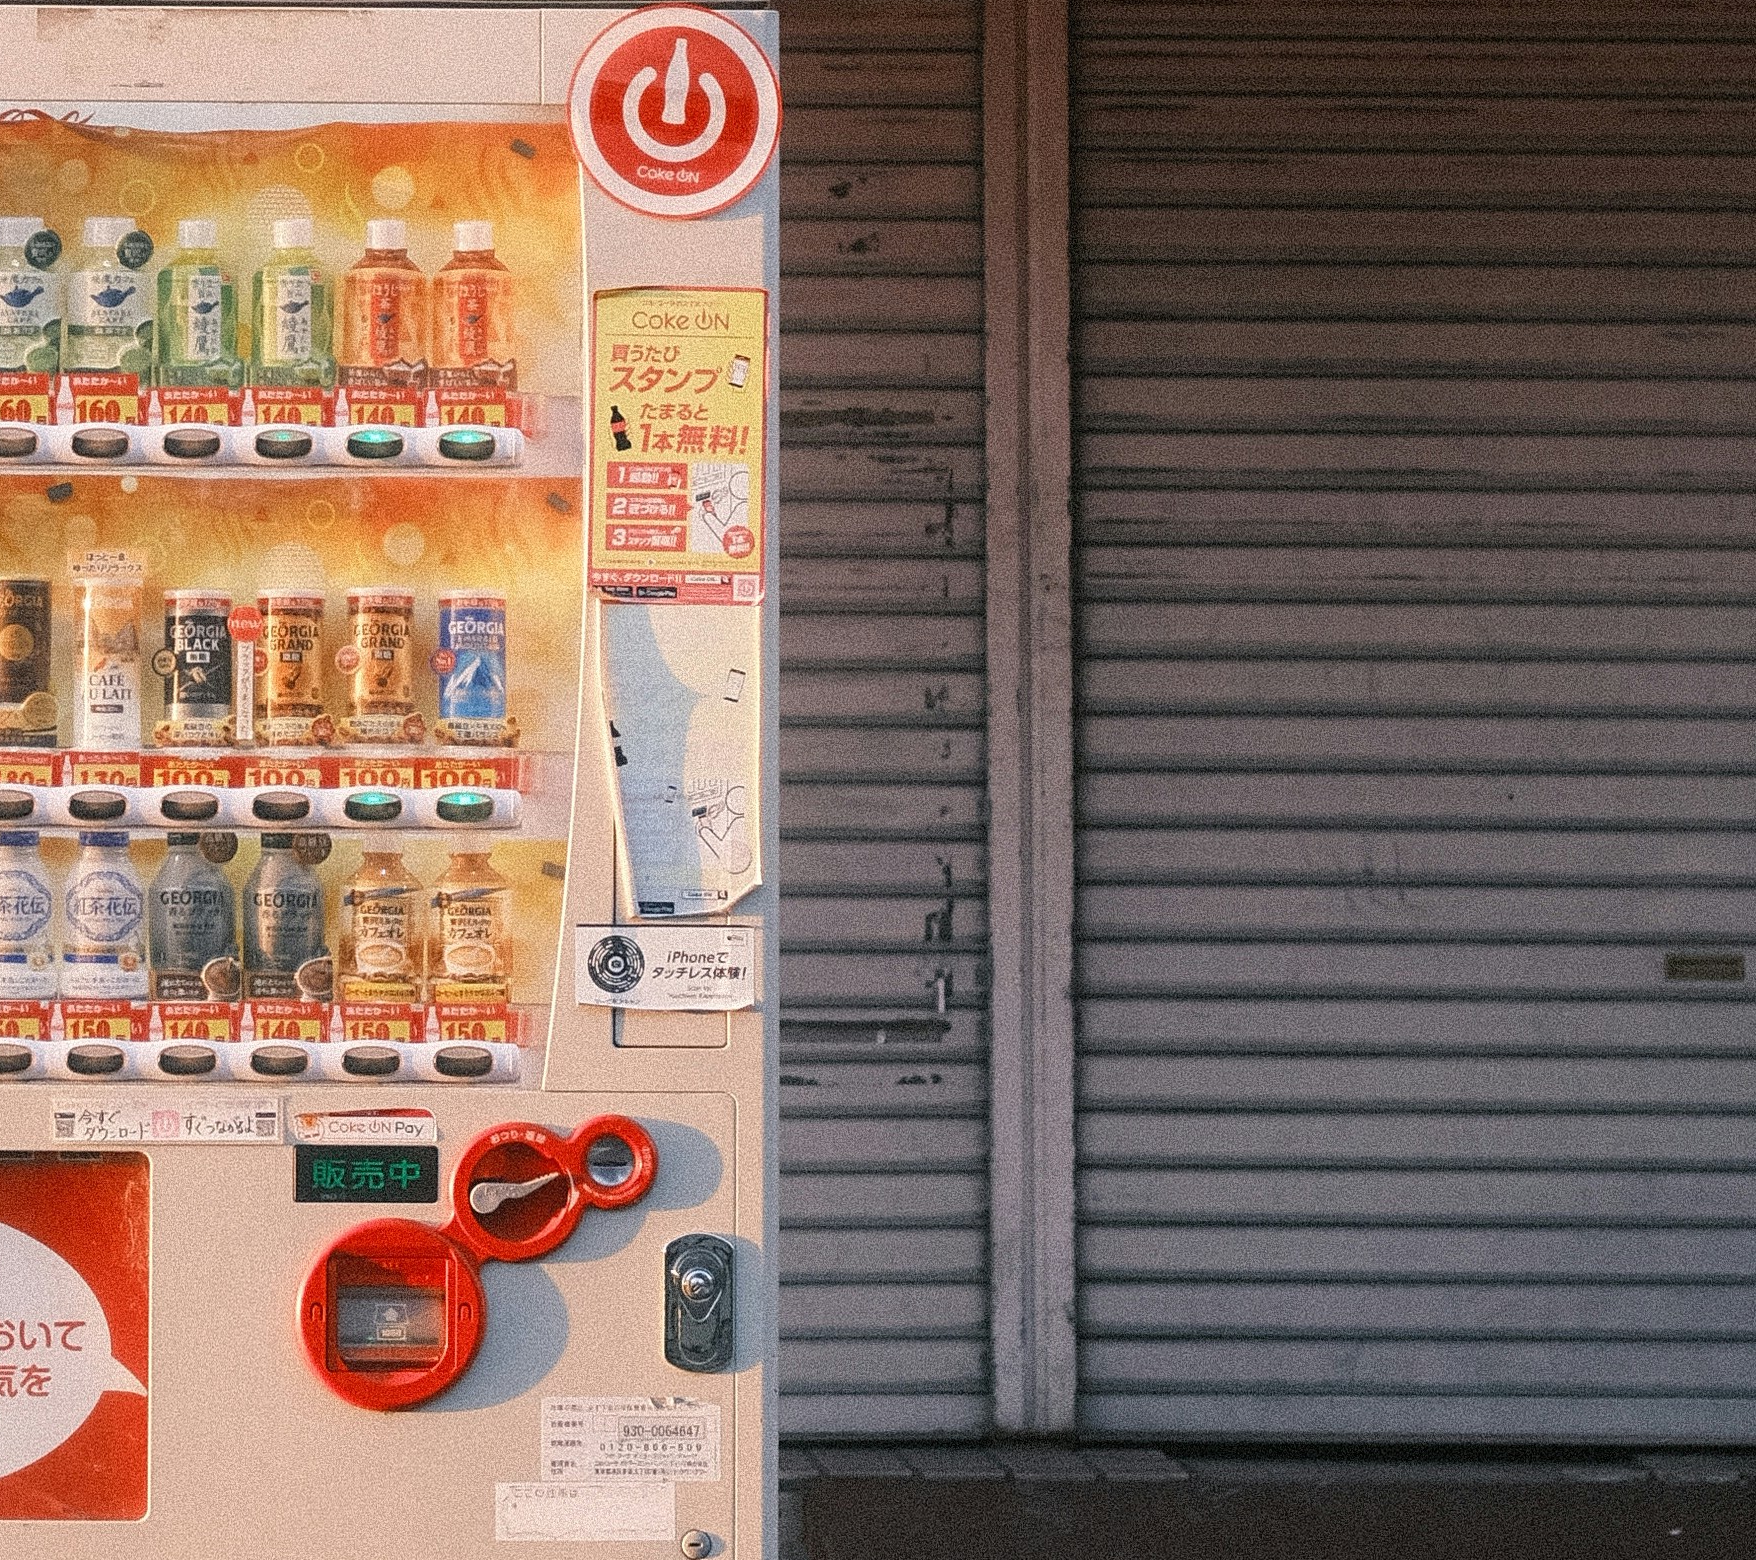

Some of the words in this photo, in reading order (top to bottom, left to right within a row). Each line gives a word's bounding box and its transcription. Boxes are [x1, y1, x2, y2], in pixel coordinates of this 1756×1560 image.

[636, 165, 674, 180] Coke
[676, 166, 700, 184] ON
[631, 311, 690, 330] Coke
[694, 308, 731, 331] ON
[609, 343, 681, 364] 買うたび
[608, 365, 723, 394] スタンプ
[639, 402, 709, 421] たまると
[639, 423, 750, 455] 1本無料!
[611, 497, 627, 515] 2
[611, 528, 627, 547] 3
[170, 620, 227, 639] GEORGIA
[264, 620, 319, 639] GEORGIA
[354, 619, 410, 638] GEORGIA
[447, 617, 504, 635] GEORGIA
[176, 638, 220, 652] BLACK
[268, 638, 314, 652] GRAND
[360, 636, 406, 649] GRAND
[102, 688, 134, 701] LAIT
[73, 896, 138, 915] 紅茶花伝
[160, 890, 225, 906] GEORGIA
[253, 892, 318, 908] GEORGIA
[359, 901, 405, 916] GEORGIA
[447, 901, 492, 916] GEORGIA
[361, 928, 404, 940] カフェオレ
[448, 928, 491, 940] カフェオレ
[666, 949, 729, 965] iPhoneで
[651, 965, 748, 981] タッチレス体験!
[79, 1108, 117, 1125] 今すぐ
[82, 1122, 152, 1141] ダウンロード
[328, 1120, 366, 1134] Coke
[368, 1118, 393, 1134] ON
[394, 1120, 424, 1138] Pay
[311, 1159, 422, 1190] 販売中
[622, 1424, 701, 1438] 930-0064647
